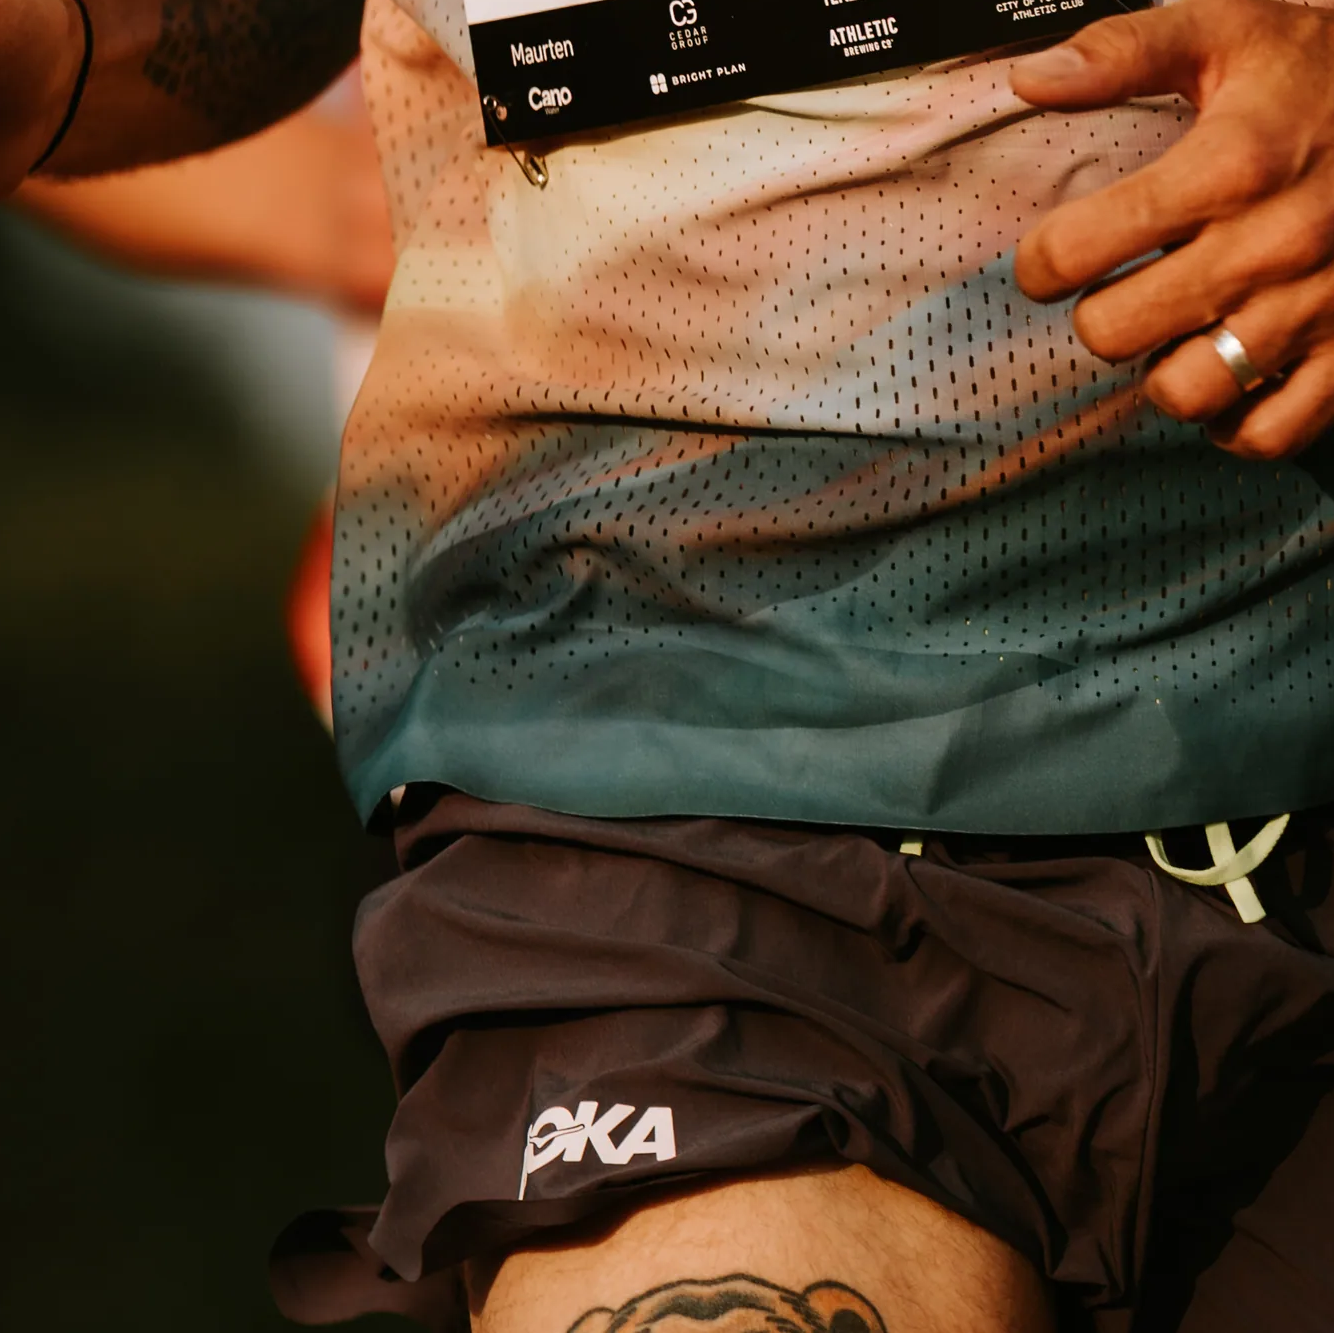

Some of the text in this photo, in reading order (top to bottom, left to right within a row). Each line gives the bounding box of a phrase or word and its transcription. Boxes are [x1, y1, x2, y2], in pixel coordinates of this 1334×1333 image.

[996, 0, 1019, 13] CITY
[1013, 4, 1057, 21] ATHLETIC
[669, 26, 707, 42] CEDAR
[829, 16, 899, 47] ATHLETIC
[510, 38, 575, 68] Maurten
[671, 35, 709, 51] GROUP
[843, 41, 881, 58] BREWING
[671, 62, 747, 86] BRIGHT PLAN
[528, 86, 573, 112] Cano
[519, 1101, 677, 1200] OKA
